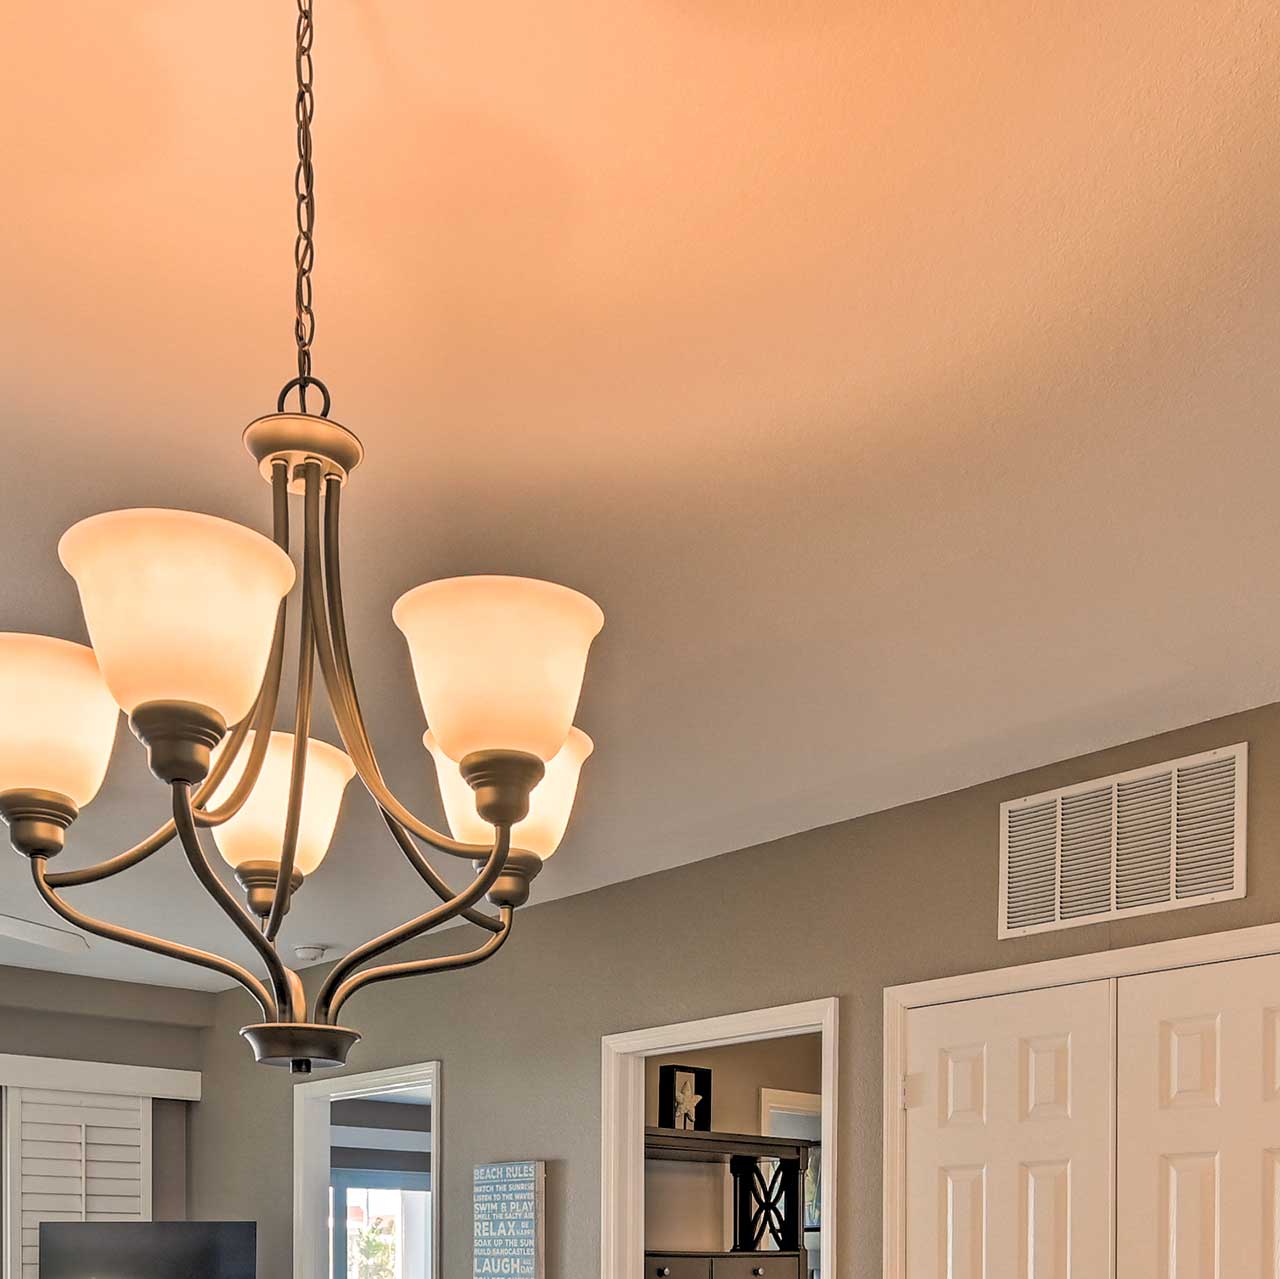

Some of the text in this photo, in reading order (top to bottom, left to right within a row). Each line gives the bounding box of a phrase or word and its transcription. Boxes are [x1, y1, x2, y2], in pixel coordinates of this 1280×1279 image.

[474, 1166, 535, 1180] BEACH RULES
[496, 1184, 506, 1192] THE
[508, 1183, 534, 1191] SUNRISE
[474, 1201, 534, 1213] SWIM & PLAY
[474, 1221, 516, 1237] RELAX
[474, 1239, 534, 1247] SOAK UP THE SUN
[474, 1248, 535, 1256] BUILD SANDCASTLES
[474, 1258, 520, 1273] LAUGH
[521, 1265, 533, 1273] DAY
